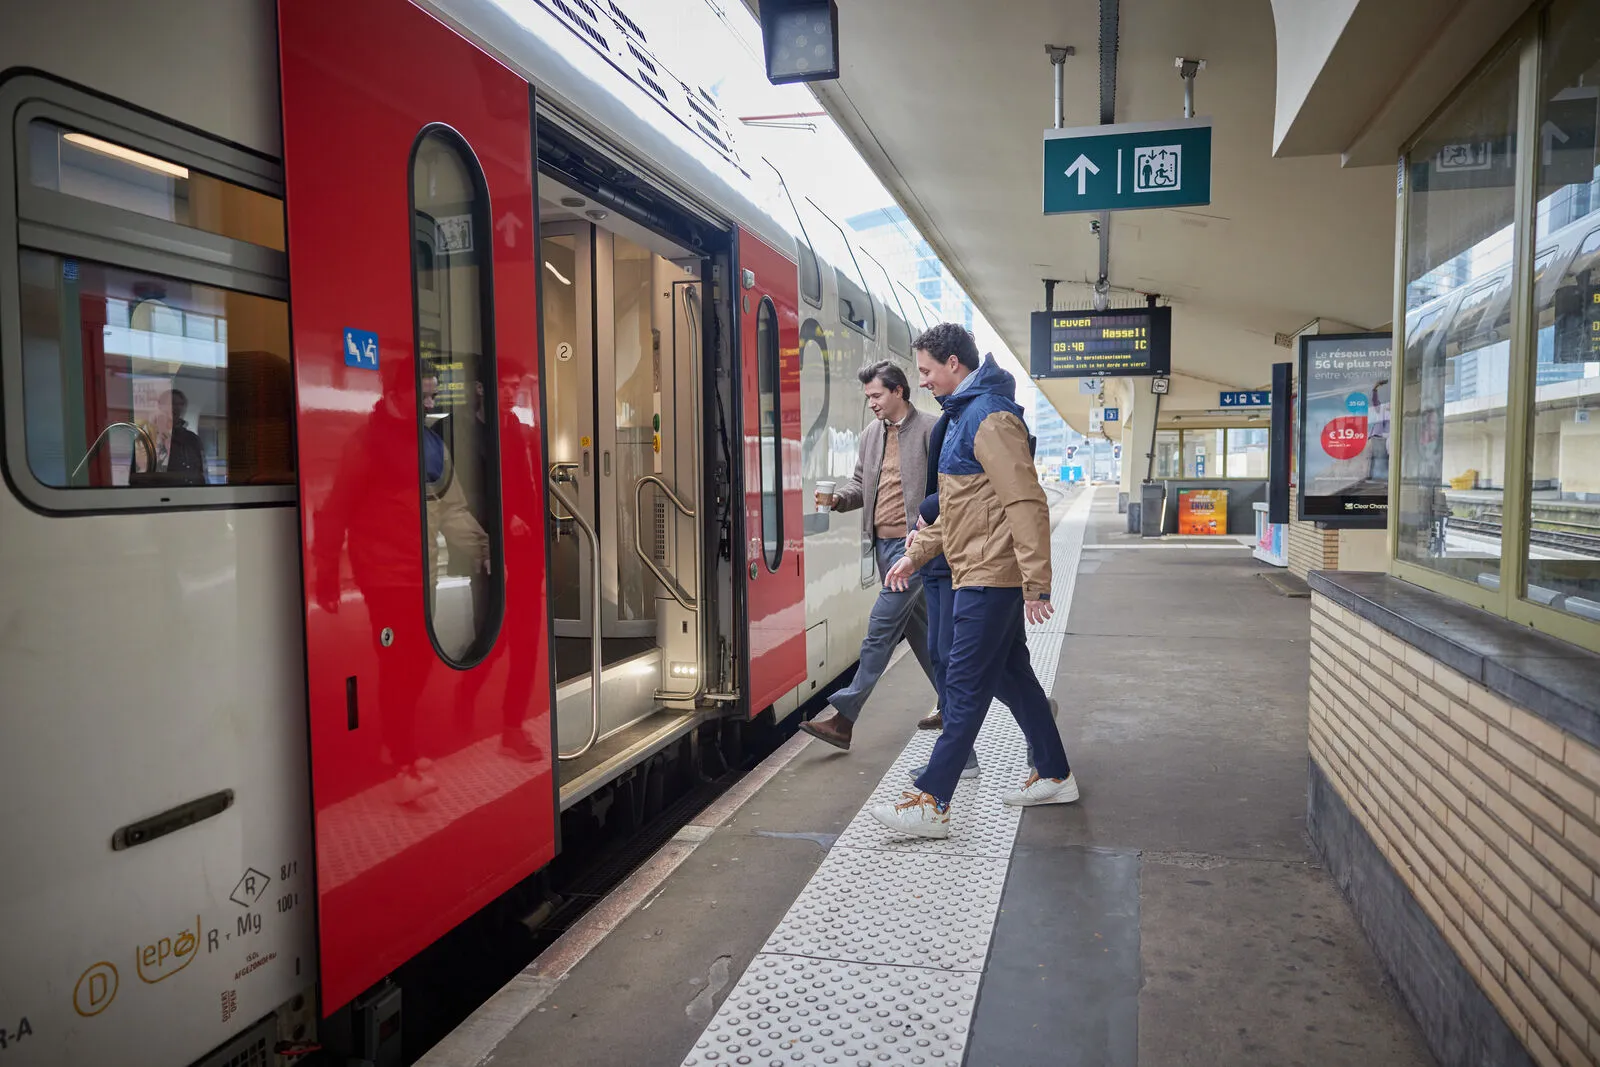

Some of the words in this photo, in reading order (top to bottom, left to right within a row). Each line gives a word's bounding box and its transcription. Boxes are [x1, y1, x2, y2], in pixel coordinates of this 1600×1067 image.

[1053, 318, 1091, 328] Leuven
[1102, 328, 1146, 339] Hasselt
[560, 345, 568, 358] 2
[1053, 341, 1085, 352] 09:48
[1134, 340, 1147, 350] IC
[1315, 351, 1327, 359] Le
[1329, 348, 1367, 358] réseau
[1315, 360, 1331, 369] 5G
[1333, 360, 1344, 369] le
[1346, 360, 1370, 370] plus
[1315, 371, 1341, 380] entre
[1191, 502, 1214, 510] ENVIES
[245, 876, 256, 896] R
[277, 894, 293, 913] 100
[207, 929, 219, 954] R
[237, 912, 262, 935] Mg
[89, 972, 107, 1006] D
